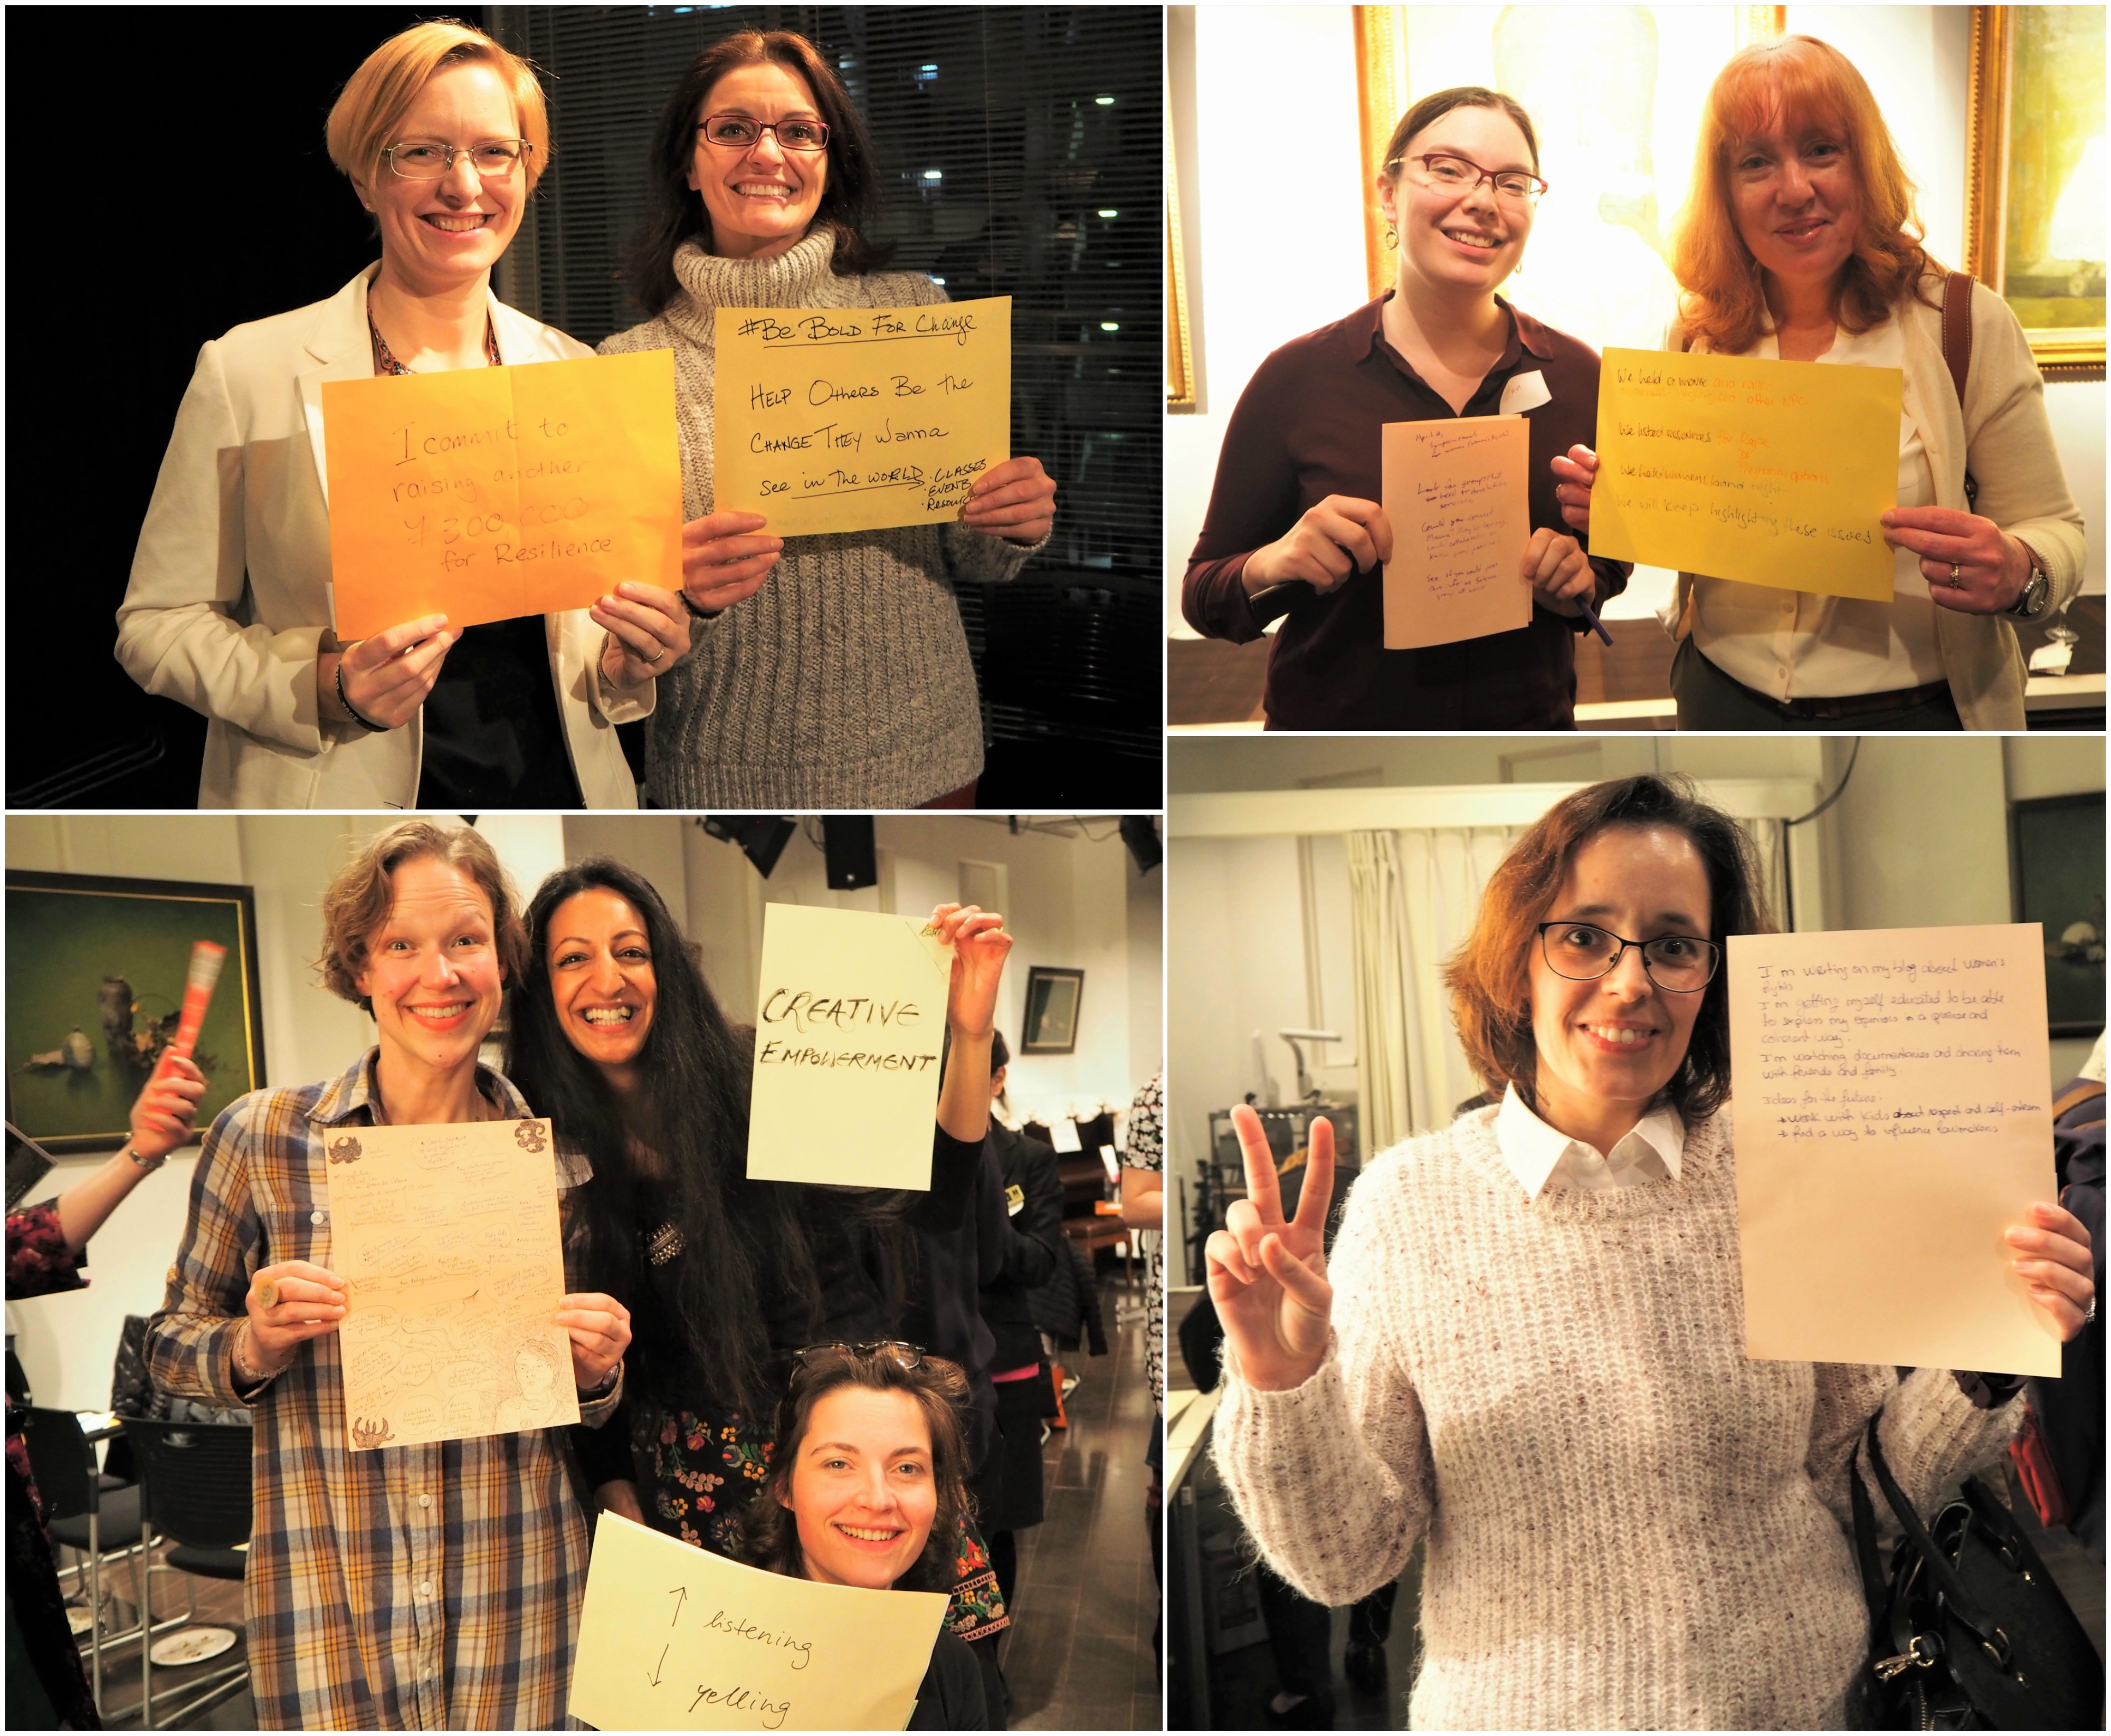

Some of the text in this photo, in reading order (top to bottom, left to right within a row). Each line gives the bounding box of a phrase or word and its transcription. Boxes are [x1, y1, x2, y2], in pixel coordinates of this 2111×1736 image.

[798, 316, 862, 340] BOLD
[915, 314, 977, 346] Change
[750, 383, 792, 410] HELP
[890, 375, 926, 398] Be
[1618, 368, 1632, 384] We
[1639, 368, 1663, 384] held
[1667, 376, 1676, 386] a
[1679, 376, 1708, 387] movie
[1714, 376, 1736, 389] and
[1746, 394, 1776, 406] other
[393, 417, 569, 466] I commit to
[750, 432, 814, 454] CHANGE
[813, 423, 862, 453] THEY
[1619, 422, 1771, 449] We listed resources for Rape
[393, 460, 592, 504] raising another
[803, 472, 825, 489] in
[1620, 464, 1635, 478] We
[1638, 464, 1665, 479] held
[1752, 482, 1788, 498] night
[1450, 518, 1465, 527] you
[1616, 494, 1632, 508] We
[1640, 498, 1659, 511] will
[1710, 502, 1779, 538] highlighting
[1783, 516, 1818, 538] these
[1827, 527, 1872, 545] issues
[441, 538, 613, 572] for Resilience
[1803, 961, 1849, 980] writing
[1852, 965, 1869, 974] on
[1873, 966, 1890, 979] my
[1893, 959, 1917, 983] blog
[1922, 958, 1959, 975] about
[762, 987, 923, 1034] CREATIVE
[1796, 993, 1840, 1017] getting
[1846, 993, 1885, 1012] myself
[1890, 990, 1941, 1005] educated
[1946, 989, 1959, 1004] to
[1962, 989, 1977, 1004] be
[1981, 989, 2005, 1005] able
[1762, 1013, 1776, 1026] to
[1782, 1017, 1824, 1028] express
[1829, 1018, 1849, 1033] my
[1906, 1013, 1914, 1021] in
[1969, 1008, 1989, 1020] and
[759, 1040, 938, 1072] EMPOWERMENT
[1760, 1053, 1786, 1063] I'm
[1793, 1050, 1847, 1065] watching
[1854, 1047, 1930, 1061] documentaries
[1933, 1046, 1951, 1058] and
[1954, 1044, 1993, 1063] sharing
[1762, 1067, 1787, 1080] with
[1789, 1064, 1832, 1080] friends
[1837, 1062, 1858, 1076] and
[1802, 1090, 1818, 1109] for
[1820, 1088, 1836, 1102] the
[1824, 1108, 1855, 1122] with
[1893, 1104, 1925, 1119] about
[1965, 1103, 1982, 1114] and
[1792, 1124, 1814, 1143] find
[1831, 1130, 1859, 1141] way
[1862, 1124, 1877, 1136] to
[1936, 1120, 1999, 1135] lawmakers
[703, 1610, 812, 1670] listening
[688, 1684, 792, 1730] yelling
